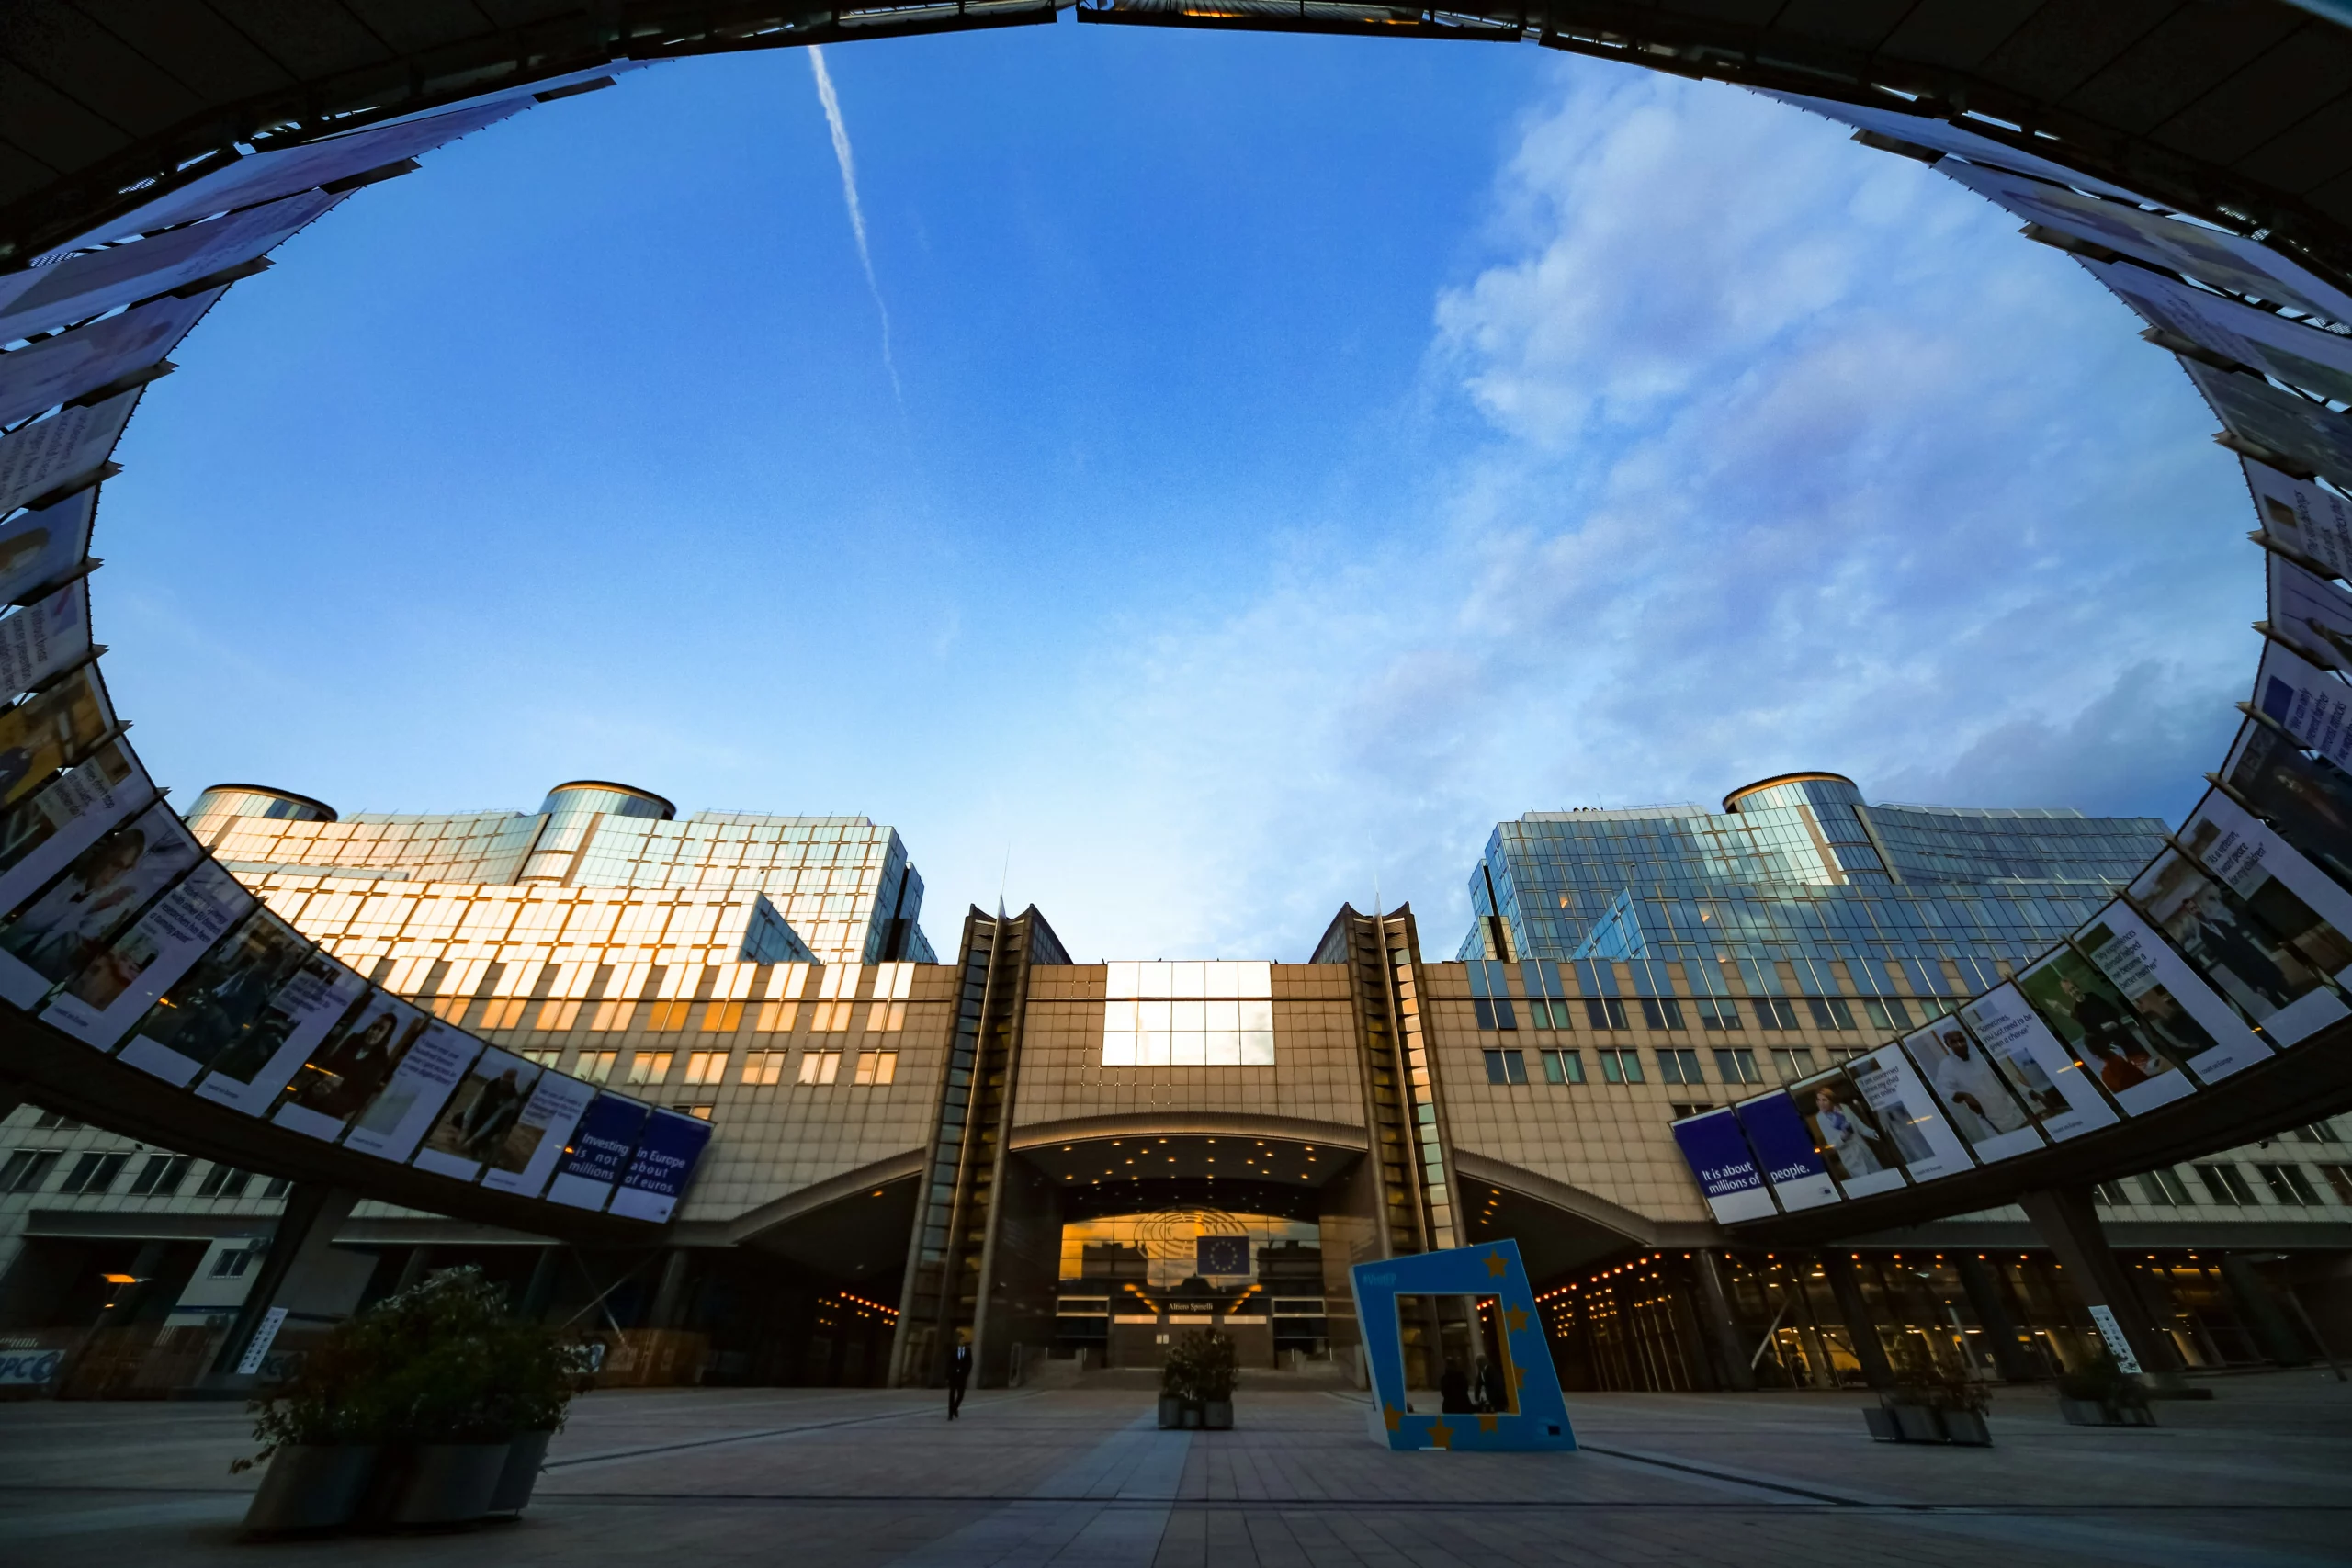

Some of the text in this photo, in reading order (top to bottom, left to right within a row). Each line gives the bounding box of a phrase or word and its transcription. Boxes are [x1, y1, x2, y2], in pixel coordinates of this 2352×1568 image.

[12, 615, 26, 641] cancer
[2299, 688, 2314, 708] only
[2311, 690, 2330, 720] further
[2295, 704, 2306, 720] can
[2329, 700, 2347, 729] attacks
[102, 793, 115, 810] stop
[2217, 831, 2240, 854] veteran,
[2220, 857, 2235, 874] want
[2232, 842, 2249, 863] peace
[2228, 874, 2239, 886] for
[2237, 867, 2249, 877] my
[171, 892, 185, 905] with
[182, 902, 198, 916] other
[194, 910, 206, 921] EU
[154, 915, 177, 935] turning
[160, 902, 192, 927] researchers
[188, 922, 200, 934] has
[196, 929, 212, 943] been
[2106, 930, 2137, 954] experiences
[2104, 939, 2142, 971] abroad helped
[2111, 970, 2122, 980] me
[2120, 957, 2142, 974] become
[2118, 957, 2157, 990] better teacher"
[1983, 1033, 1995, 1043] you
[1993, 1027, 2005, 1038] just
[2003, 1020, 2018, 1032] need
[1989, 1040, 2005, 1052] given
[2007, 1025, 2029, 1042] chance"
[2216, 1056, 2234, 1066] Europe
[1872, 1066, 1900, 1081] concerned
[1886, 1075, 1900, 1085] child
[2068, 1120, 2083, 1128] Europe
[574, 1145, 669, 1179] is not about
[582, 1132, 686, 1169] Investing in Europe
[568, 1161, 676, 1195] millions of euros.
[1702, 1160, 1754, 1182] It is about
[1708, 1162, 1810, 1195] millions of people.
[1169, 1302, 1213, 1312] Altiero Spinelli
